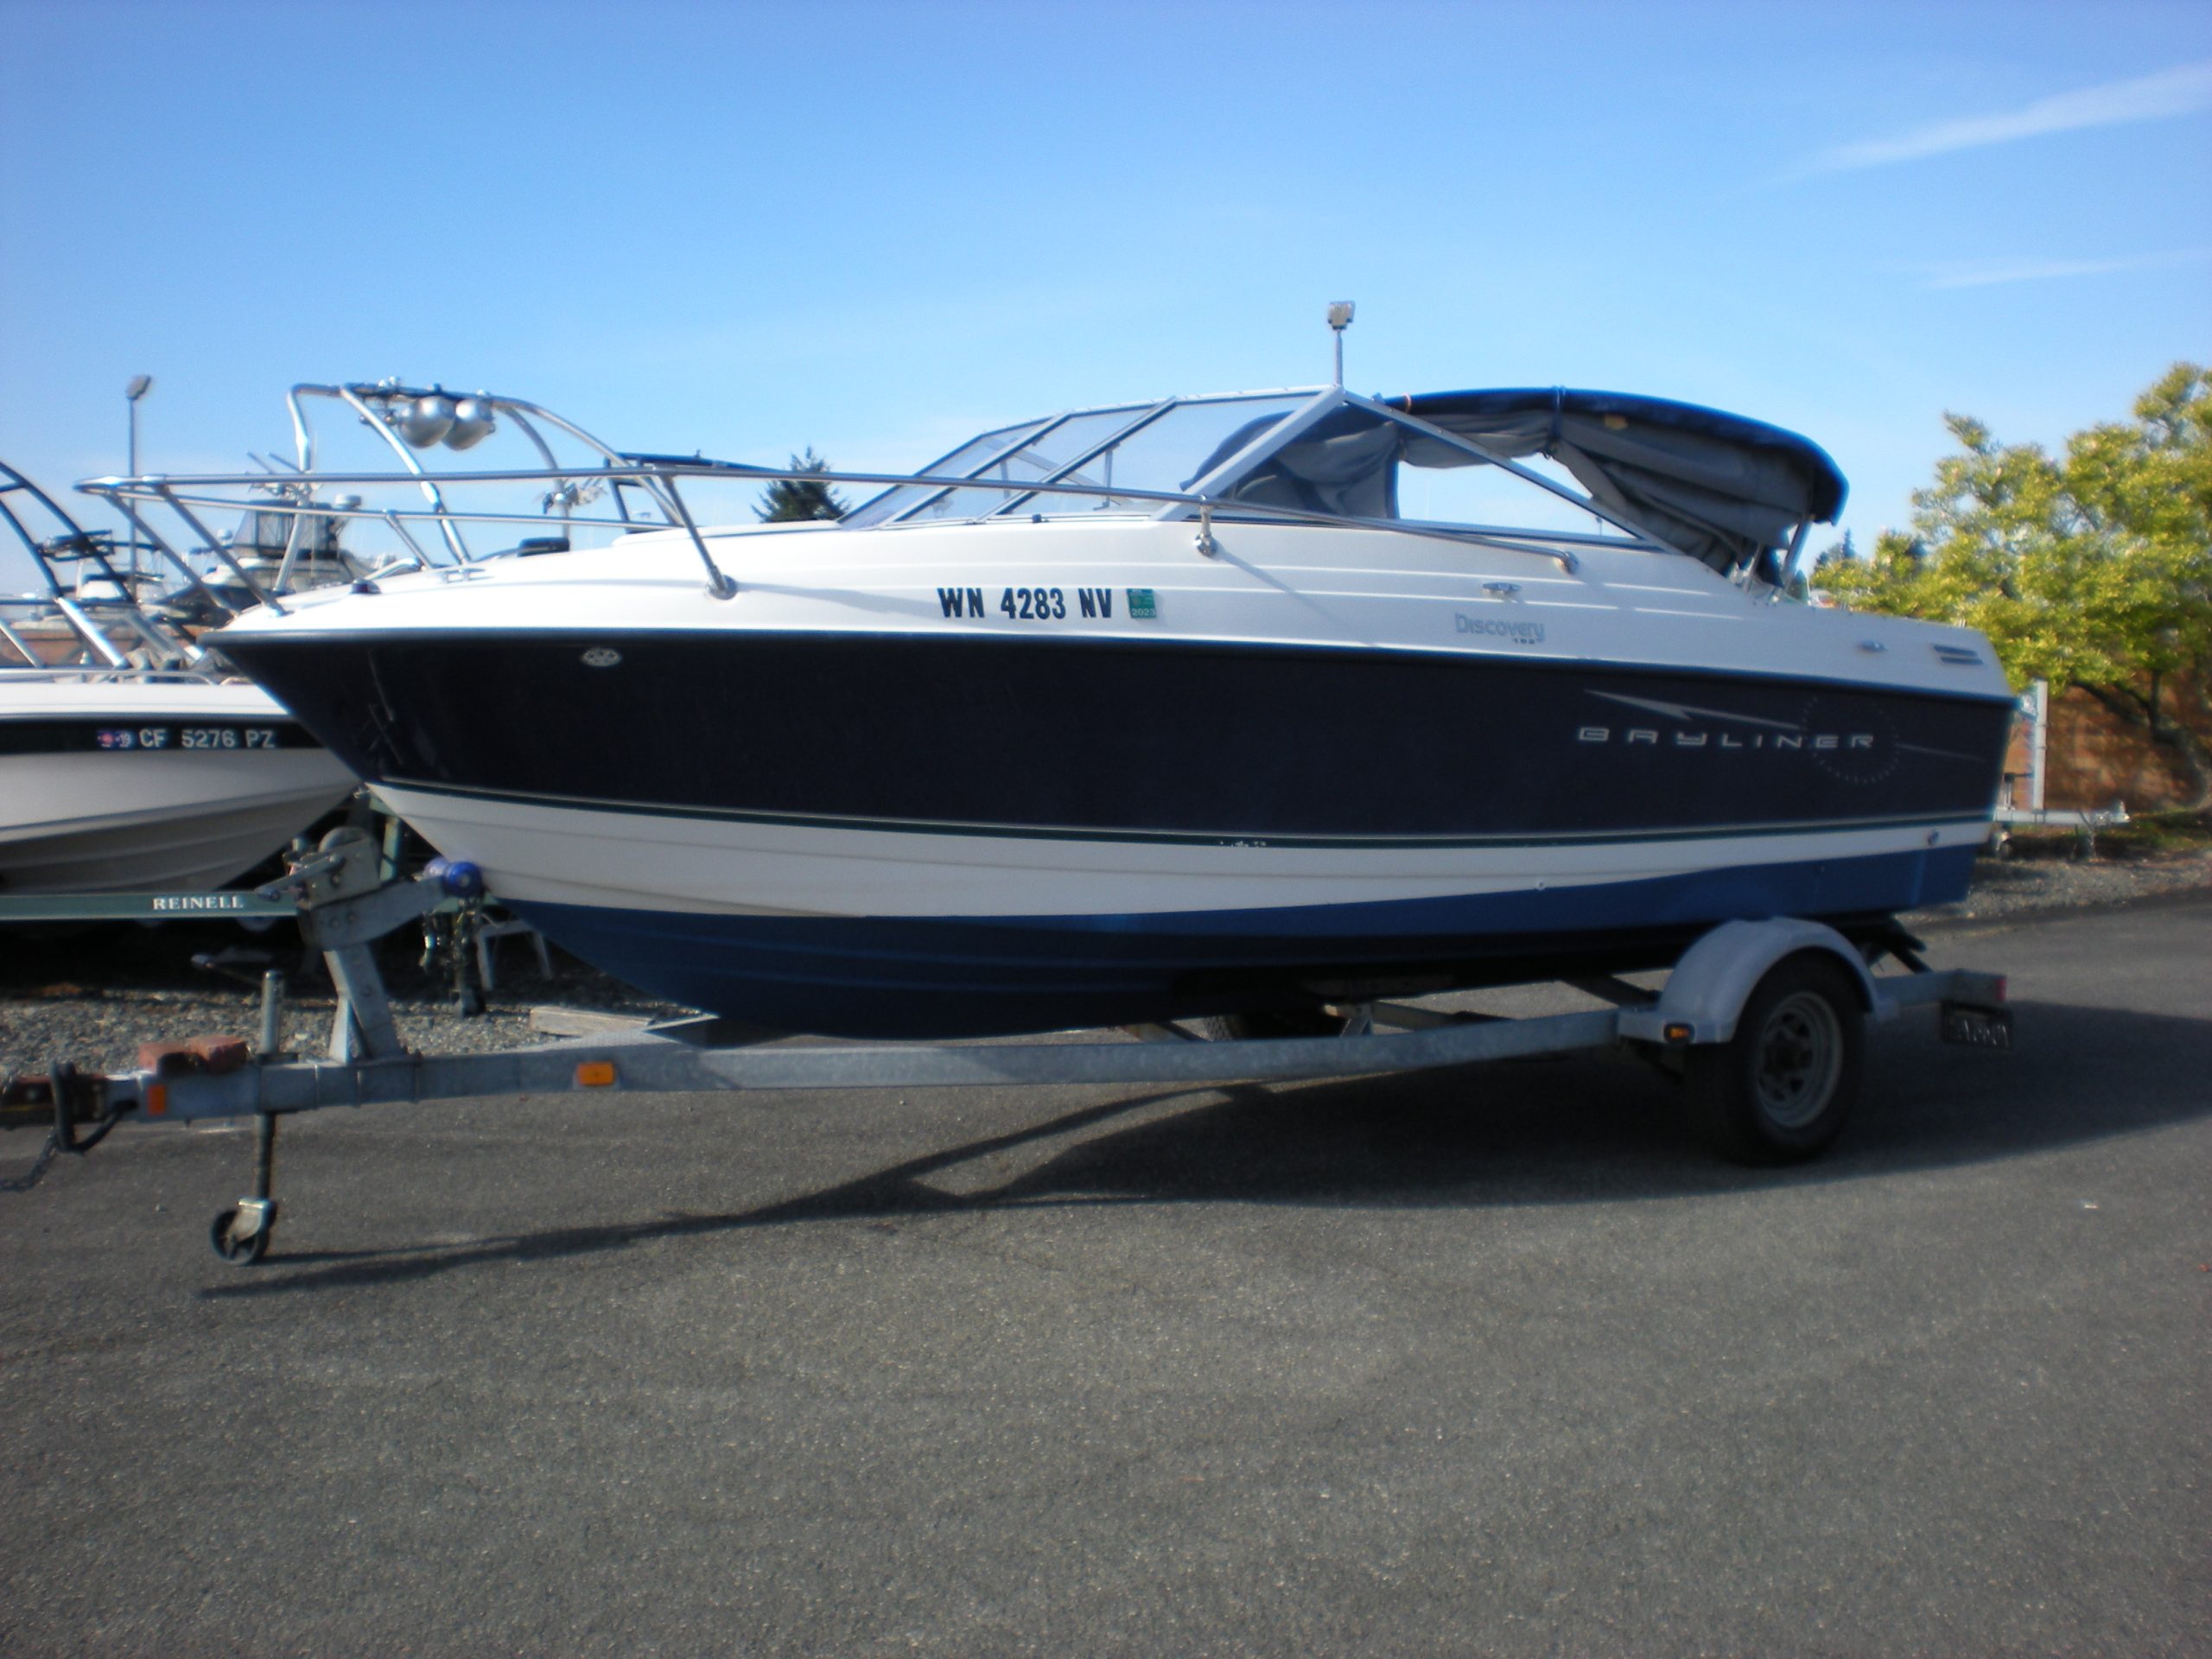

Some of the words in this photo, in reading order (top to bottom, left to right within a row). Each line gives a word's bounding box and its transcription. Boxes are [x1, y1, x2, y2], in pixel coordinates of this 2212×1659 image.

[937, 588, 985, 618] WN
[1000, 588, 1066, 620] 4283
[1078, 588, 1112, 618] NV
[1132, 607, 1156, 616] 2023
[1454, 613, 1545, 642] Discovery
[138, 728, 167, 747] CF
[181, 729, 236, 748] 5276
[245, 729, 275, 748] PZ
[1578, 727, 1874, 748] BAYLINER
[152, 895, 244, 910] REINELL
